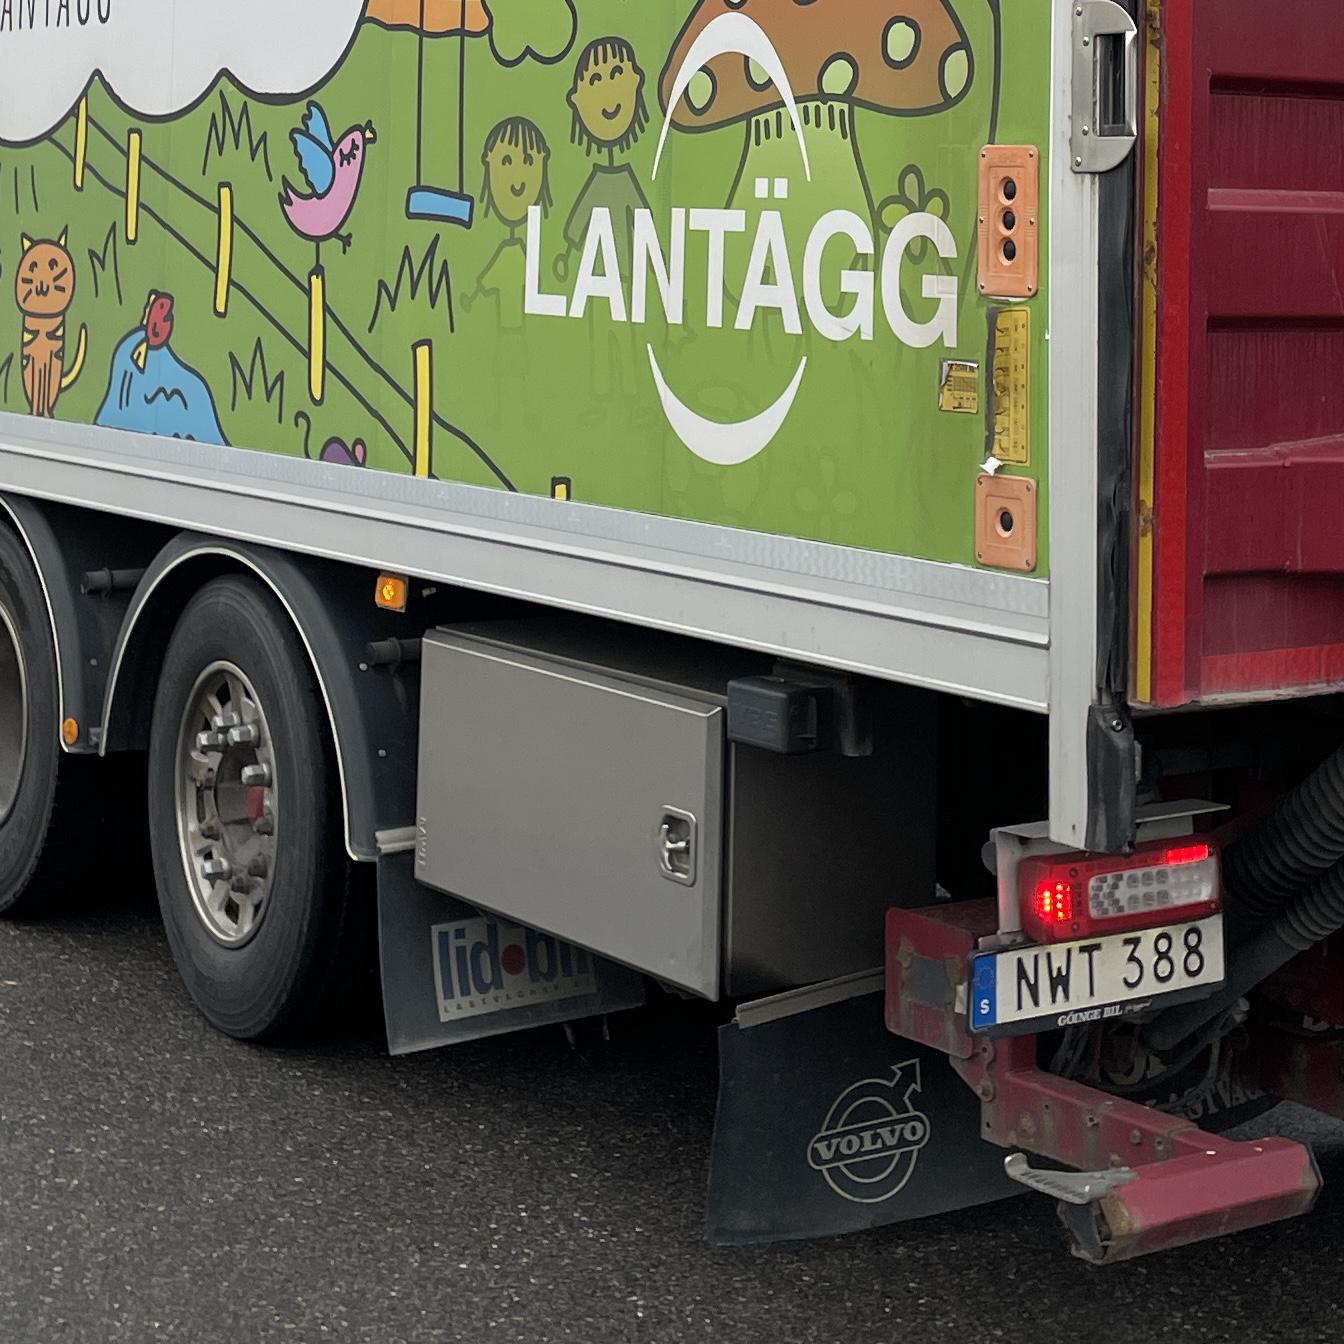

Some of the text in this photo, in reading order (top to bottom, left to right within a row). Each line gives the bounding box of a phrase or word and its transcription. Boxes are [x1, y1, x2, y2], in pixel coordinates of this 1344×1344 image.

[525, 178, 958, 348] LANTÄGG
[1017, 927, 1204, 1011] NWT 388
[979, 998, 990, 1015] S
[813, 1120, 925, 1161] VOLVO
